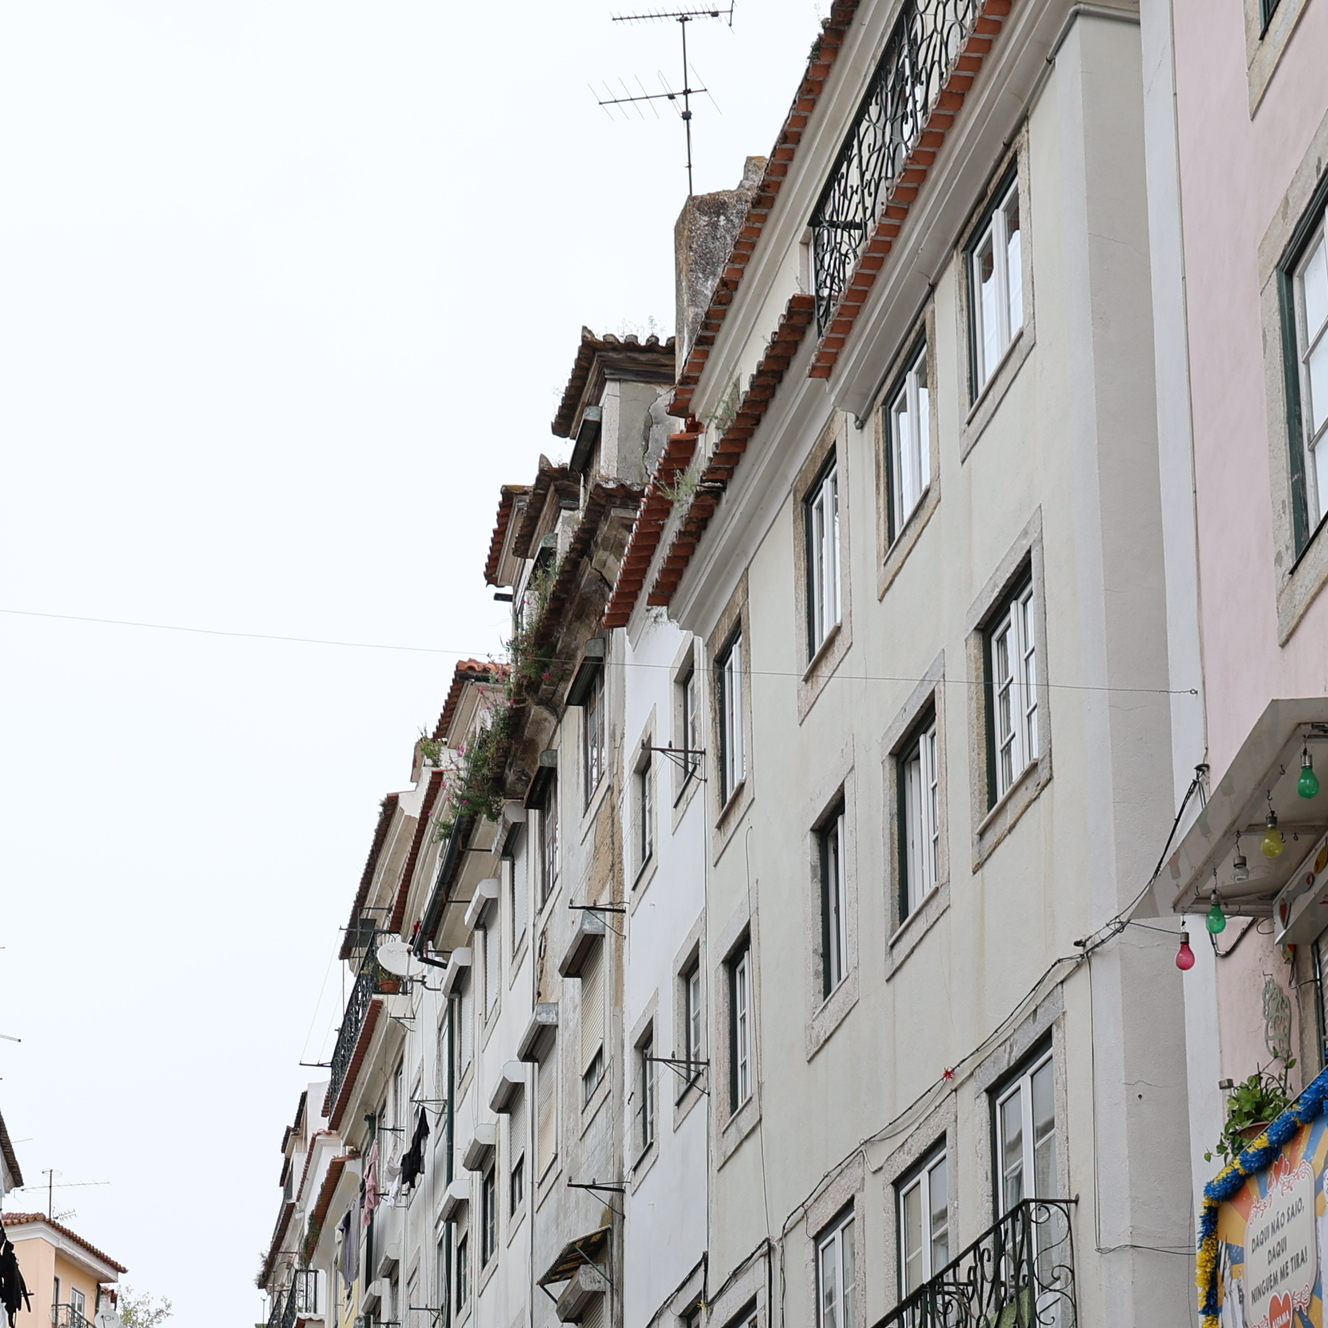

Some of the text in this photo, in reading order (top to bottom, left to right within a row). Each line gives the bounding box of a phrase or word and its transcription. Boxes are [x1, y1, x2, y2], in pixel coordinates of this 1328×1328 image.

[1252, 1197, 1305, 1255] DAQUI NÃO SAIO,
[1267, 1235, 1287, 1265] DAQUI
[1251, 1245, 1308, 1306] NINGUÉM ME TIRA!
